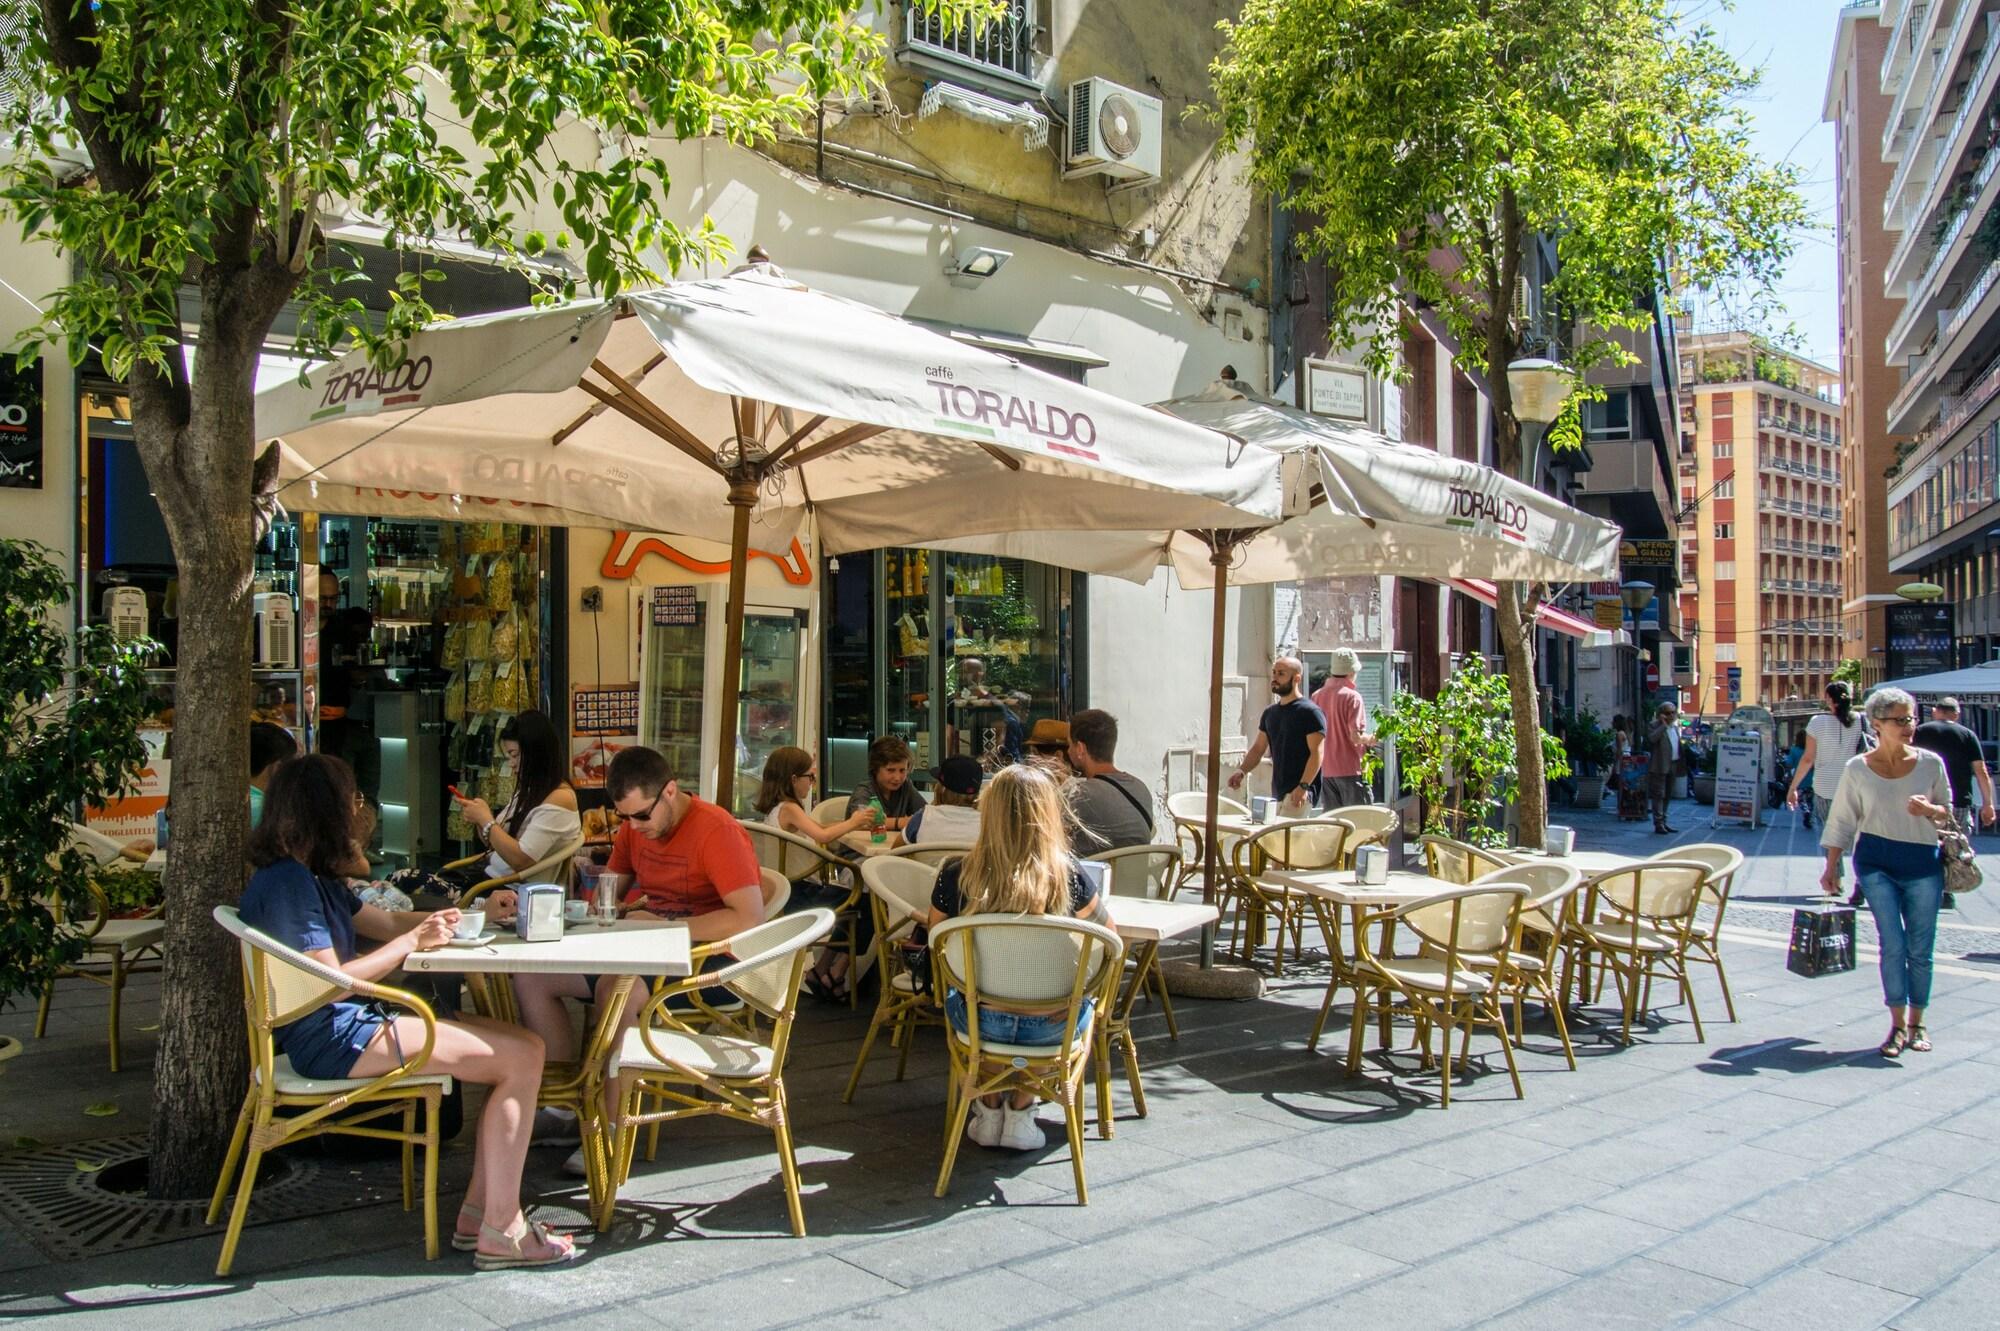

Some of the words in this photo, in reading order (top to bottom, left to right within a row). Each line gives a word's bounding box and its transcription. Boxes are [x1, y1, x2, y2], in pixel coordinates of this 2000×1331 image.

[924, 365, 954, 380] caffè
[319, 355, 432, 409] TORALDO
[1334, 379, 1344, 388] VIA
[926, 379, 1097, 448] TORALDO
[1449, 487, 1527, 532] TORALDO
[1641, 549, 1671, 557] GIALLO
[1589, 581, 1620, 596] MORENO
[420, 959, 431, 970] 6
